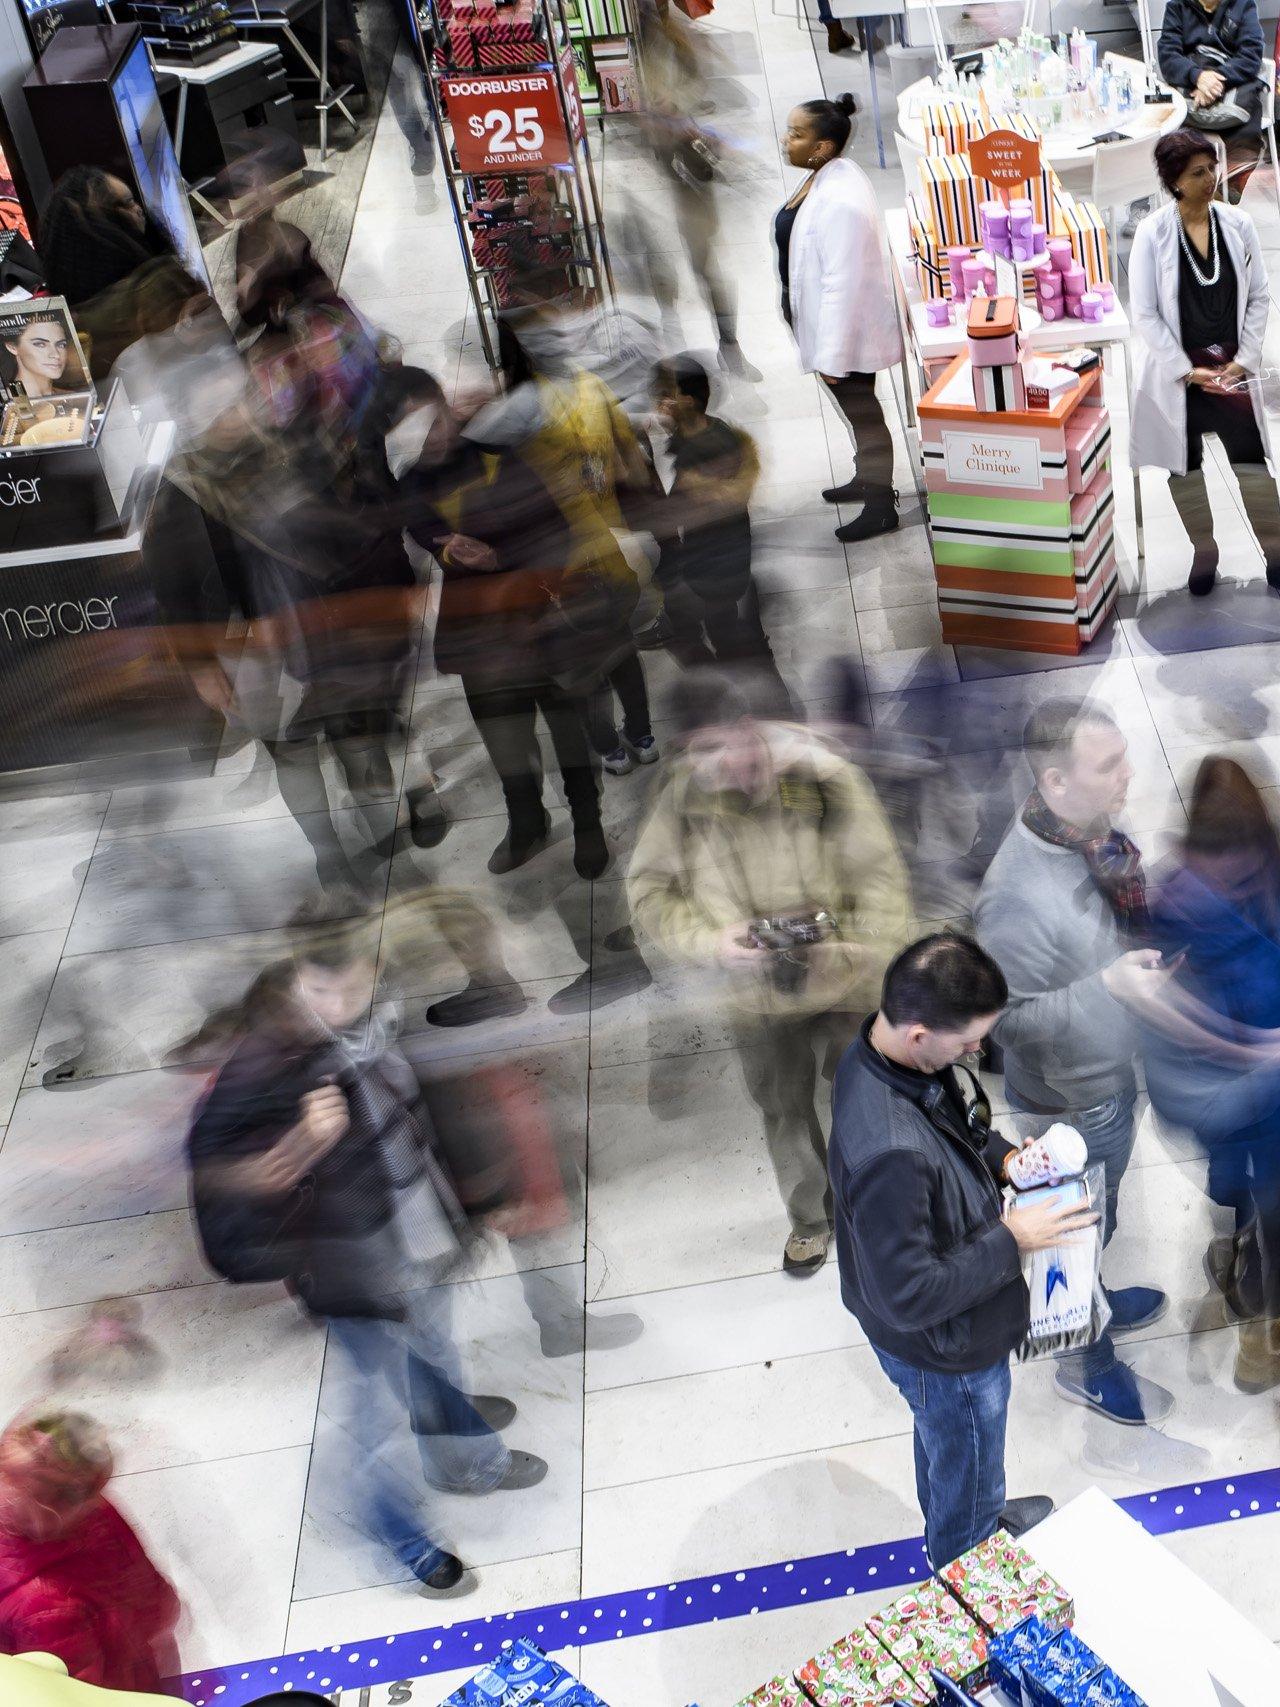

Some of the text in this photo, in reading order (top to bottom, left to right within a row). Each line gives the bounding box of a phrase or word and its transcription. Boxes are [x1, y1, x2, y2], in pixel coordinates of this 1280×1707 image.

[448, 78, 548, 97] DOORBUSTER
[468, 107, 545, 153] $25
[484, 152, 543, 164] AND UNDER
[986, 150, 1023, 160] SWEET
[991, 168, 1022, 178] WEEK
[971, 443, 1011, 459] Merry
[965, 458, 1020, 475] Clinique
